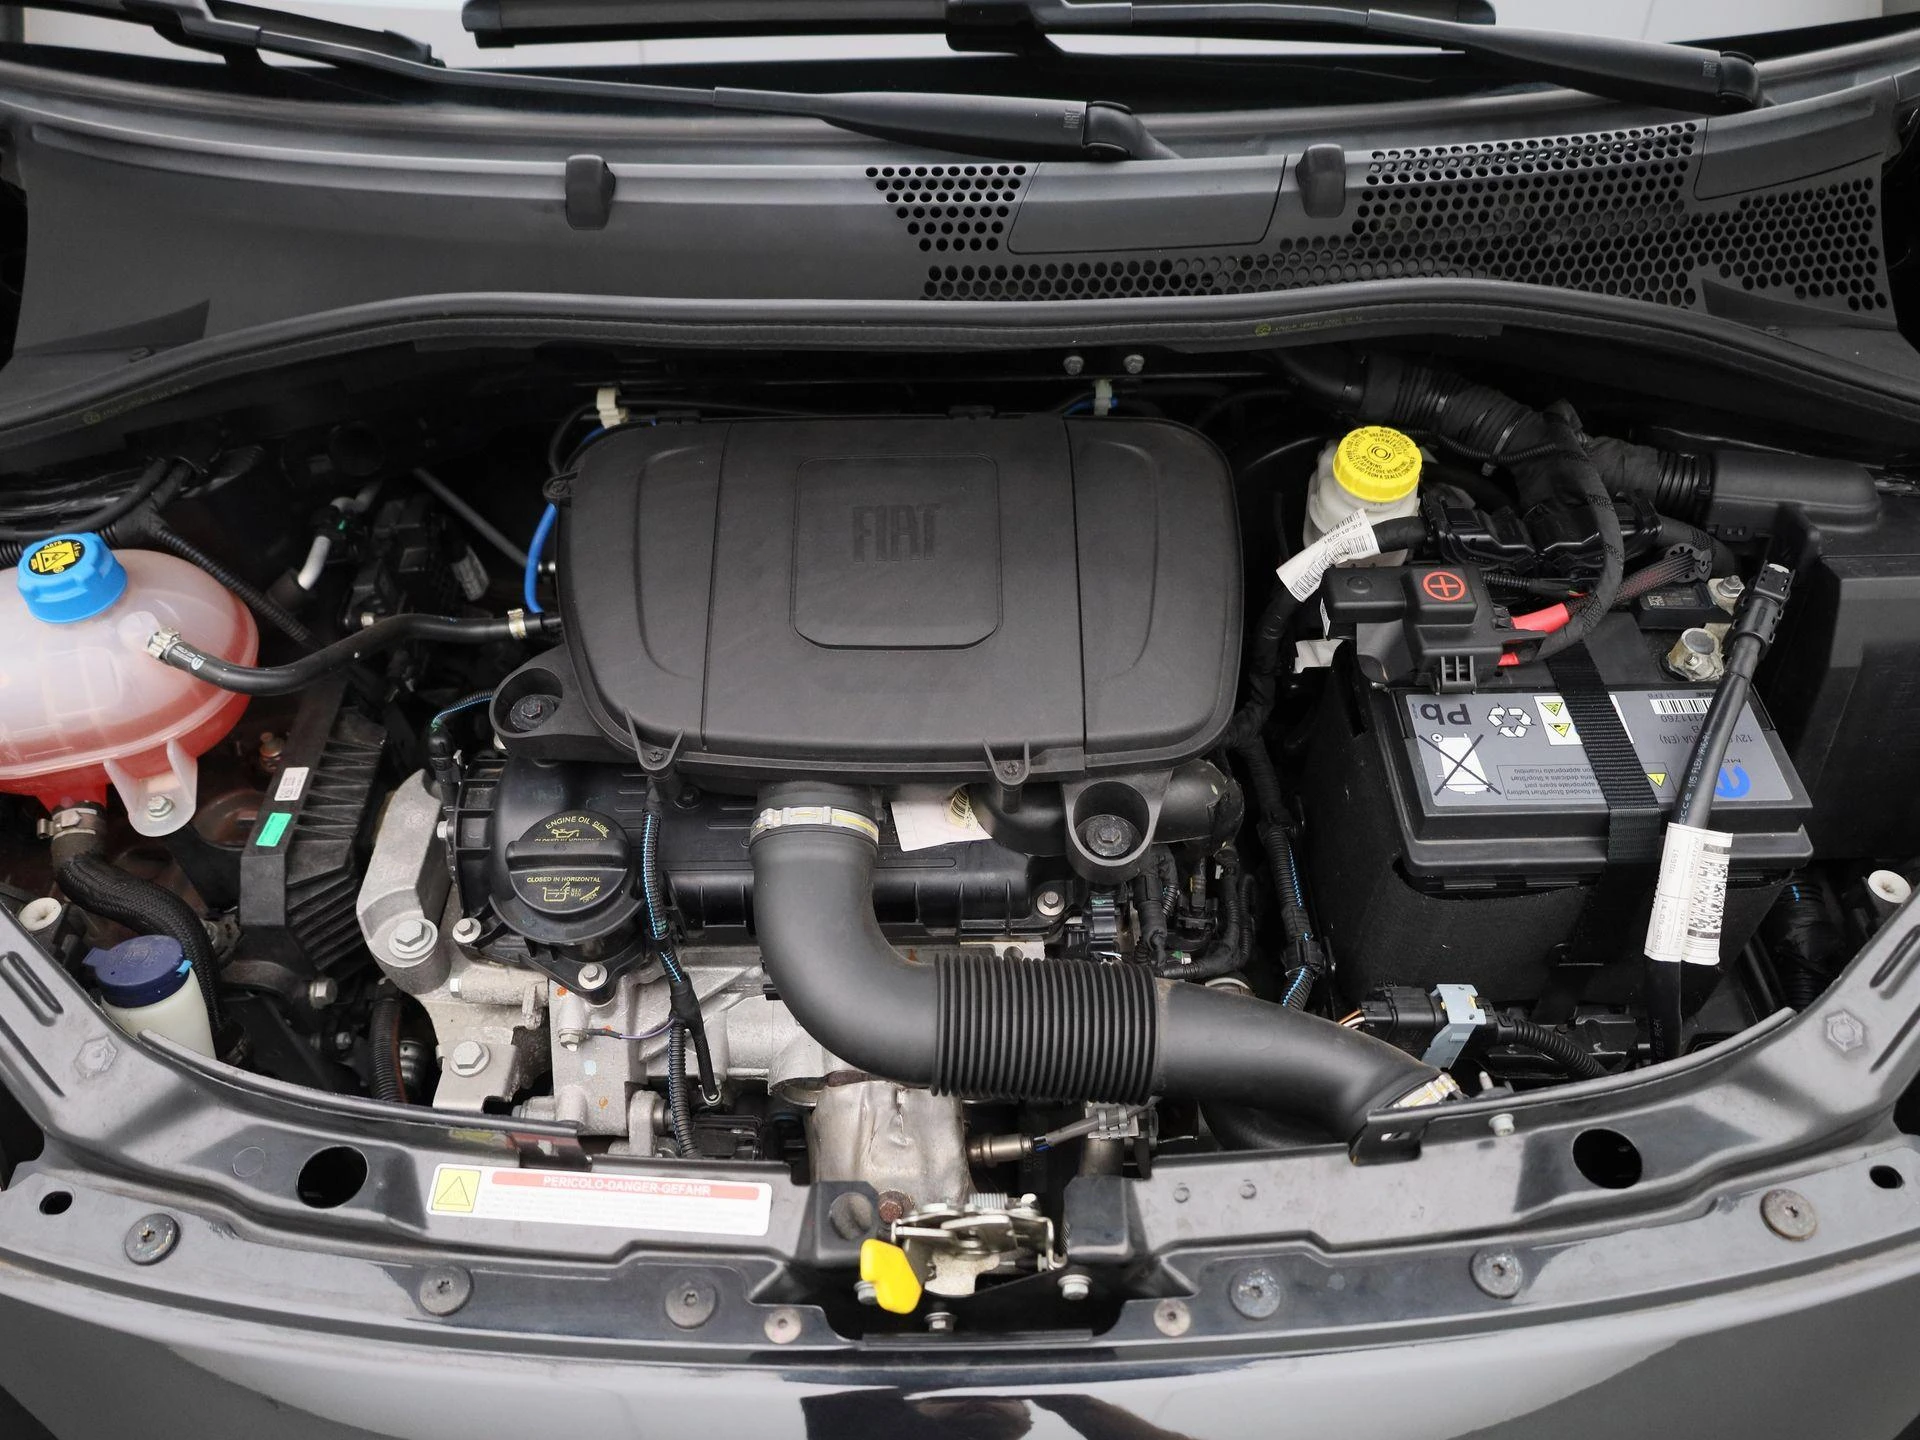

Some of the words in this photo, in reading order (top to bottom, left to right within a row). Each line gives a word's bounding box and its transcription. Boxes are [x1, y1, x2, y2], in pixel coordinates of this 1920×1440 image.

[853, 503, 941, 563] FIAT
[1420, 704, 1472, 726] Pb
[545, 816, 577, 830] ENGINE
[578, 816, 591, 825] OIL
[593, 820, 610, 833] CLOSE
[543, 1176, 711, 1196] PERICOLO-DANGER-GEFAHR
